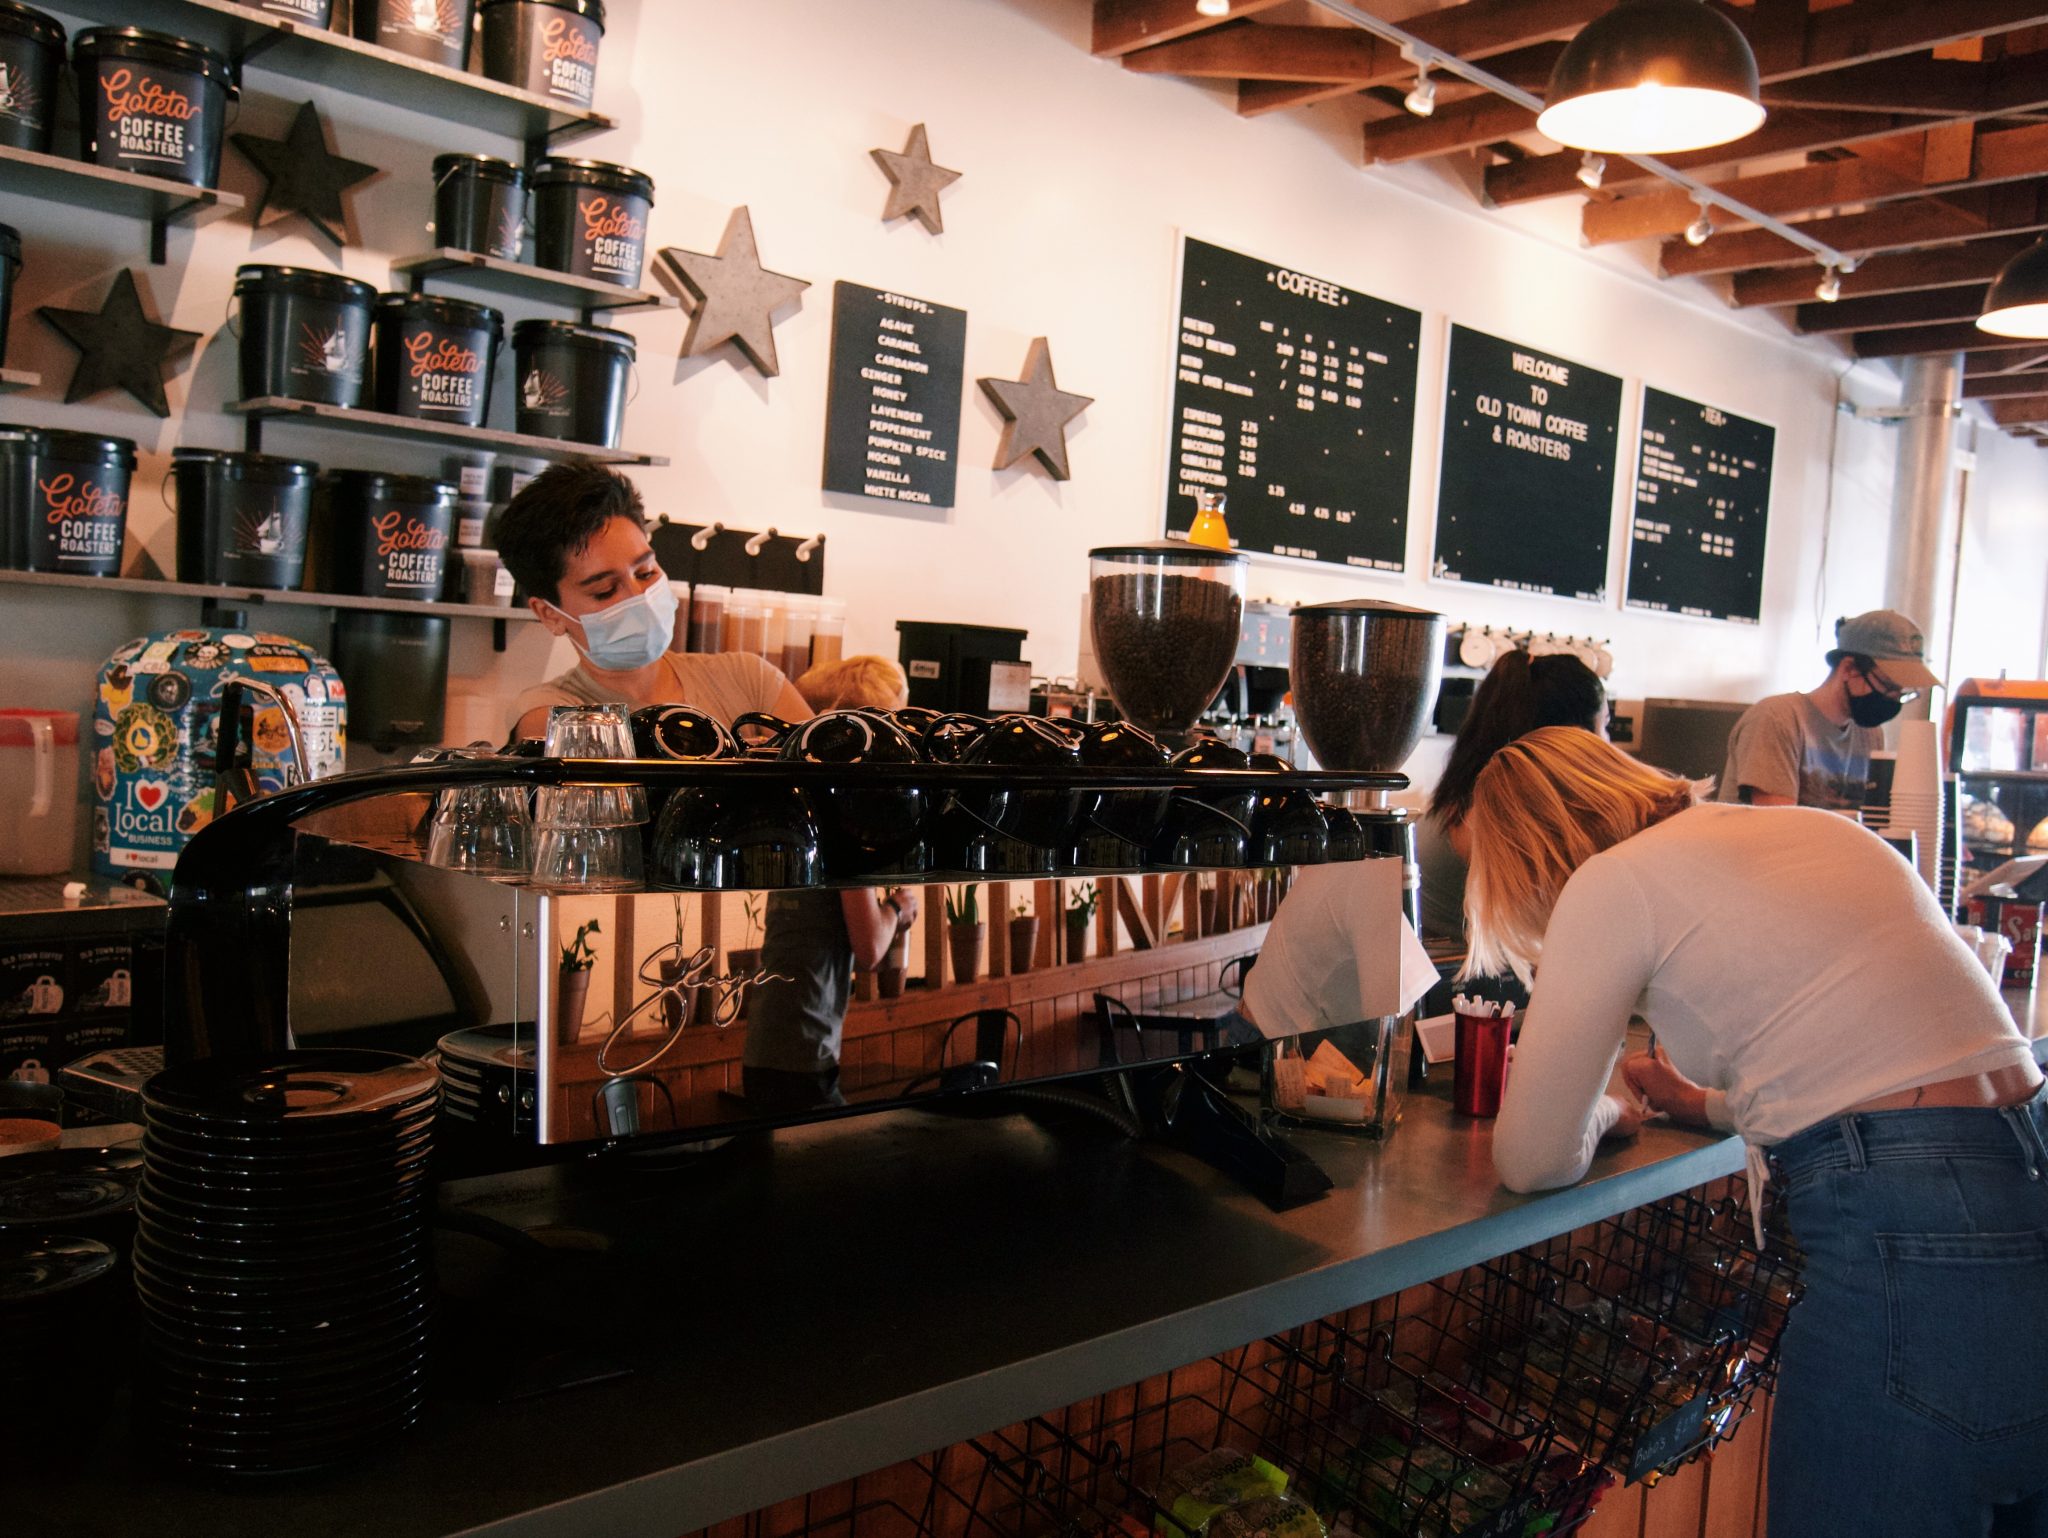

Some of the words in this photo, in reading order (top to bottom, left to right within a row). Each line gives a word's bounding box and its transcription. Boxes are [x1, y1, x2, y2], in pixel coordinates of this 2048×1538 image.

[552, 58, 592, 87] COFFEE
[100, 68, 202, 121] Goleta
[120, 116, 184, 144] COFFEE
[119, 135, 184, 158] ROASTERS
[595, 236, 637, 261] COFFEE
[1277, 270, 1340, 306] COFFEE
[880, 317, 914, 334] AGAVE
[404, 331, 486, 377] Goleta
[877, 335, 921, 354] CARAMEL
[861, 367, 902, 385] GINGER
[1512, 352, 1569, 386] WELCOME
[421, 373, 472, 395] COFFEE
[872, 386, 907, 402] HONEY
[420, 389, 472, 407] ROASTERS
[1531, 385, 1548, 405] TO
[871, 403, 923, 423] LAVENDER
[1476, 395, 1502, 417] OLD
[1506, 403, 1541, 428] TOWN
[1546, 415, 1588, 441] COFFEE
[869, 420, 932, 441] PEPPERMINT
[868, 436, 912, 454] PUMPKIN
[915, 446, 947, 461] SPICE
[1492, 425, 1502, 443] &
[1506, 428, 1571, 460] ROASTERS
[867, 451, 901, 466] MOCHA
[866, 468, 911, 484] VANILLA
[38, 473, 127, 524] Goleta
[864, 484, 897, 498] WHITE
[898, 490, 931, 504] MOCHA
[61, 520, 117, 541] COFFEE
[371, 511, 449, 556] Goleta
[59, 538, 115, 554] ROASTERS
[388, 551, 438, 572] COFFEE
[387, 567, 437, 583] ROASTERS
[125, 781, 134, 810] I
[128, 834, 172, 846] BUSINESS
